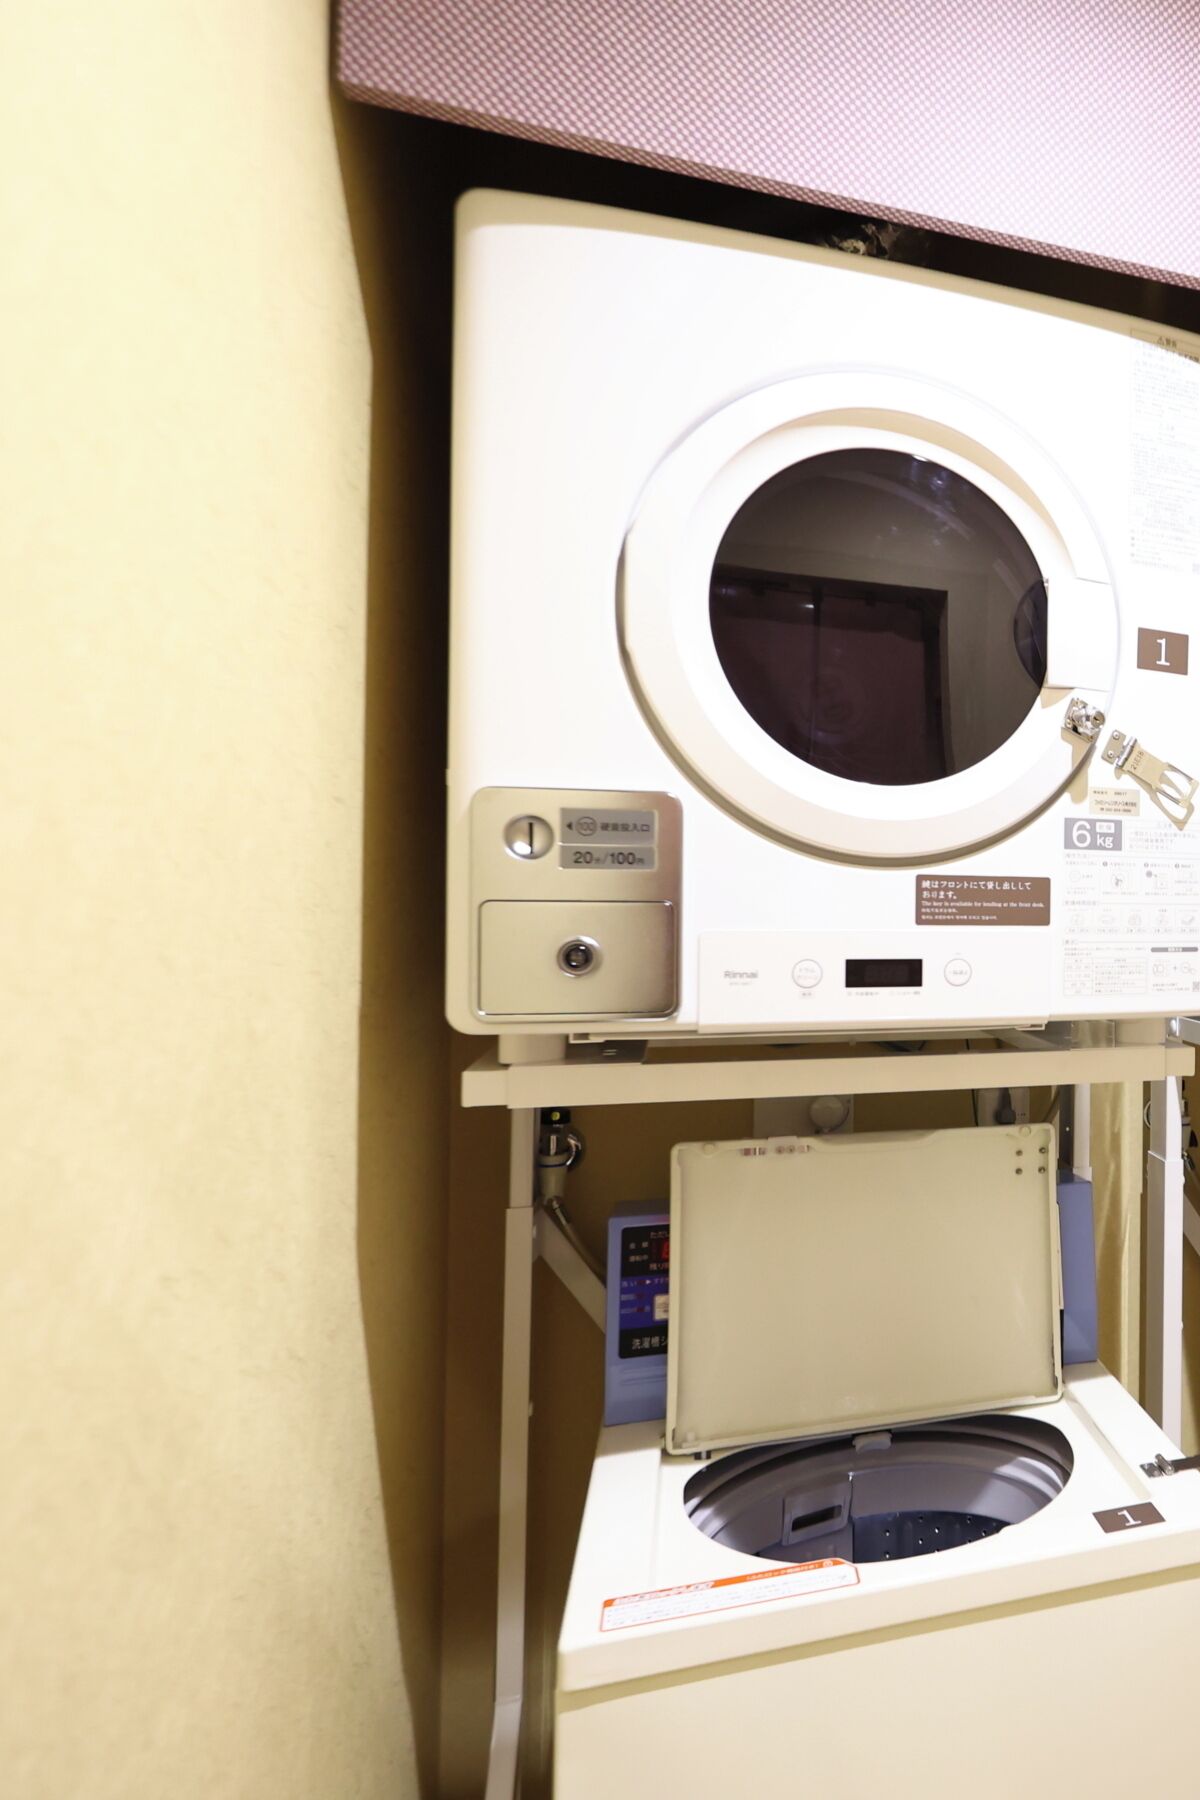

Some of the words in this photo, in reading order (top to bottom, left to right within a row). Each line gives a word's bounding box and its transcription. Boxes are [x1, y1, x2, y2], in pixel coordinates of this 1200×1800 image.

[1156, 637, 1171, 667] 1
[1072, 820, 1092, 848] 6
[1096, 834, 1114, 849] kg
[921, 879, 1032, 890] 鍵はフロントにて貸し出しして
[921, 890, 957, 900] おります。
[723, 970, 758, 980] Rinnai
[1117, 1509, 1143, 1527] 1
